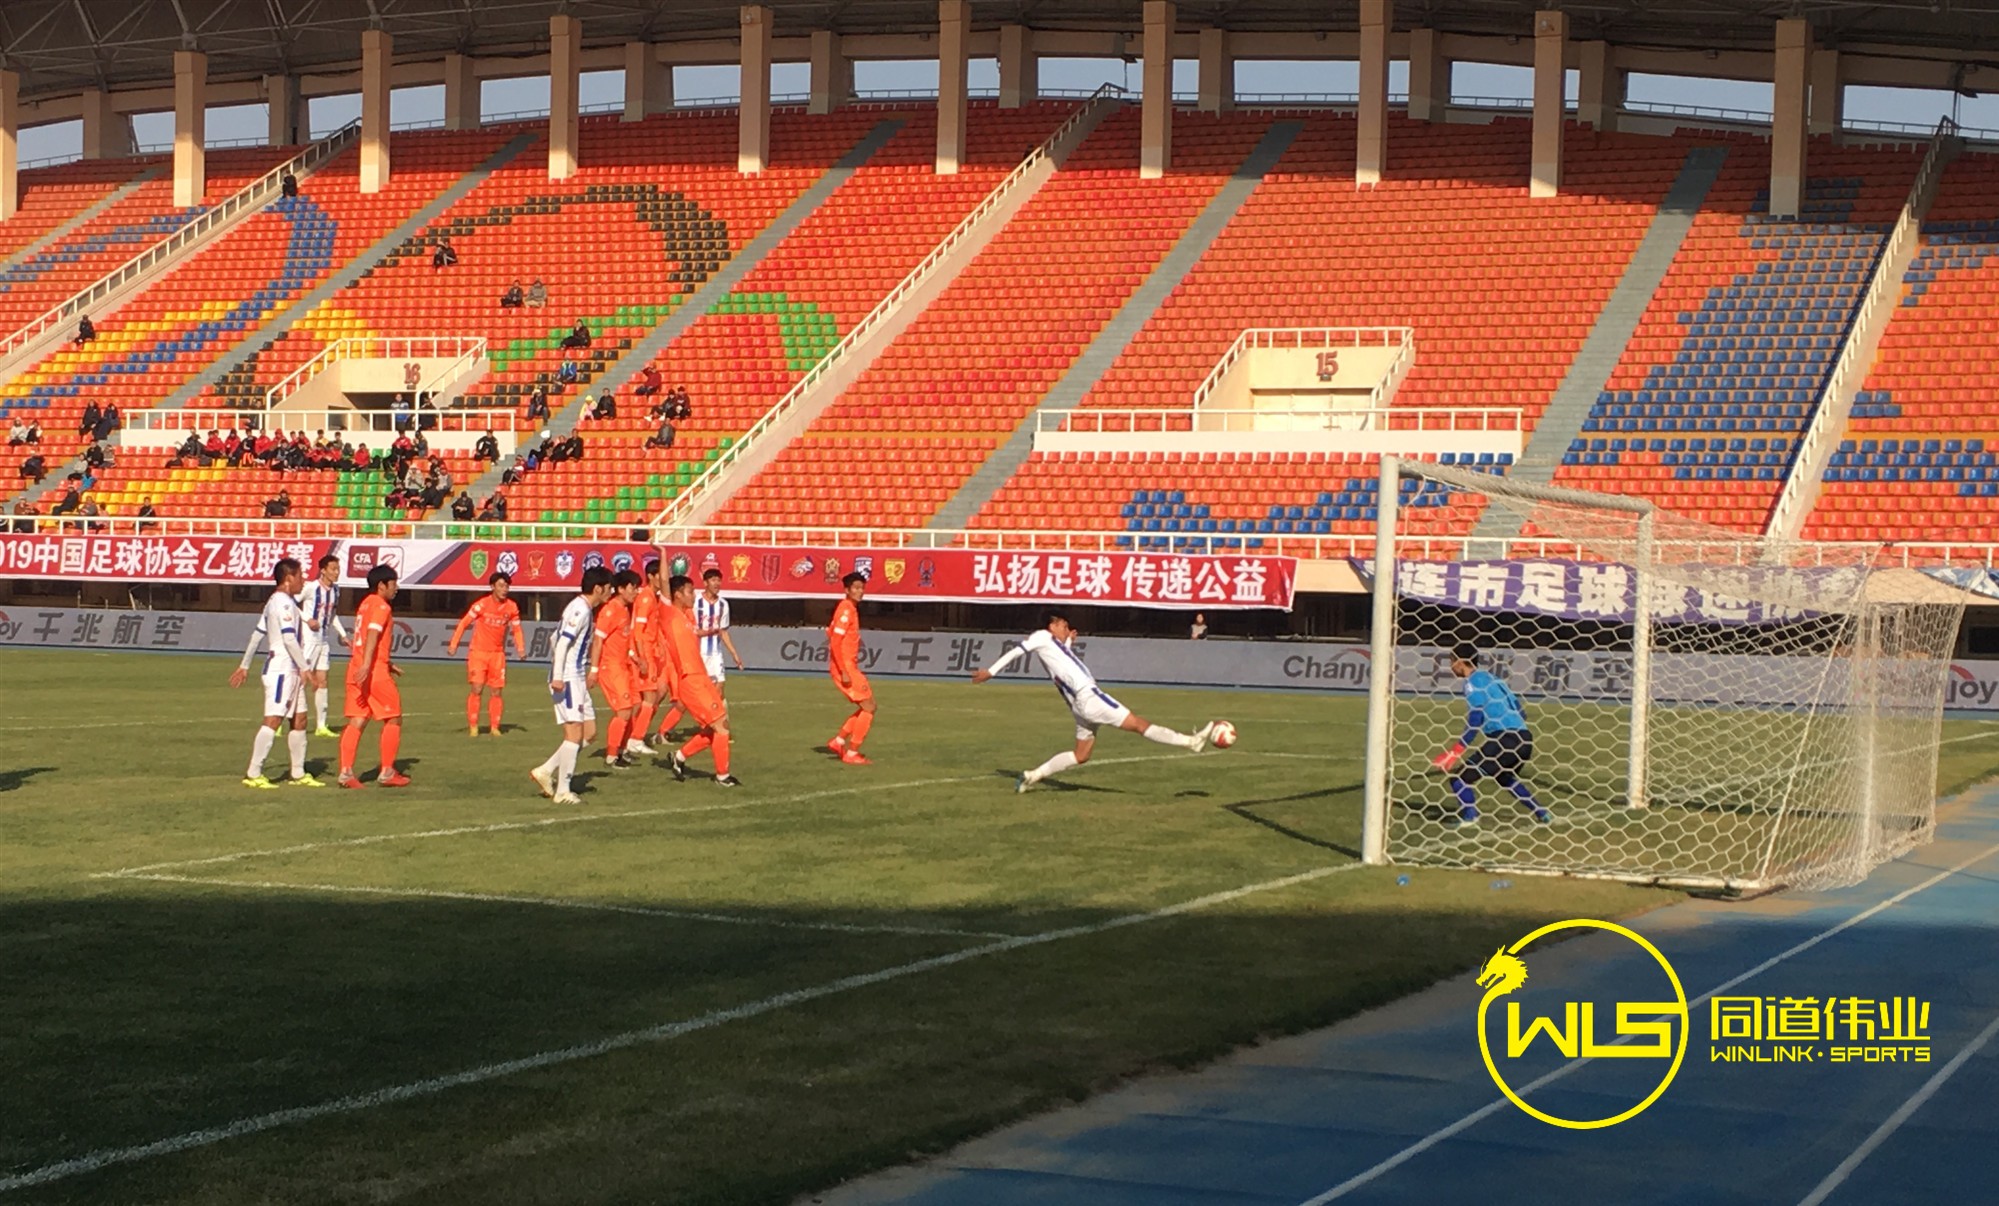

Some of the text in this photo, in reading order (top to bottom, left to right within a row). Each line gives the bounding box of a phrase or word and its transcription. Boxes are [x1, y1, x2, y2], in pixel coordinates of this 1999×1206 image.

[403, 363, 421, 384] 16
[1315, 351, 1339, 376] 15
[353, 552, 371, 564] CFA
[974, 554, 1266, 601] 弘扬足球 传递公益
[33, 612, 185, 645] 千兆航空
[780, 640, 882, 668] Chaoy
[898, 637, 1086, 674] 千兆航
[1283, 655, 1399, 685] Chanj
